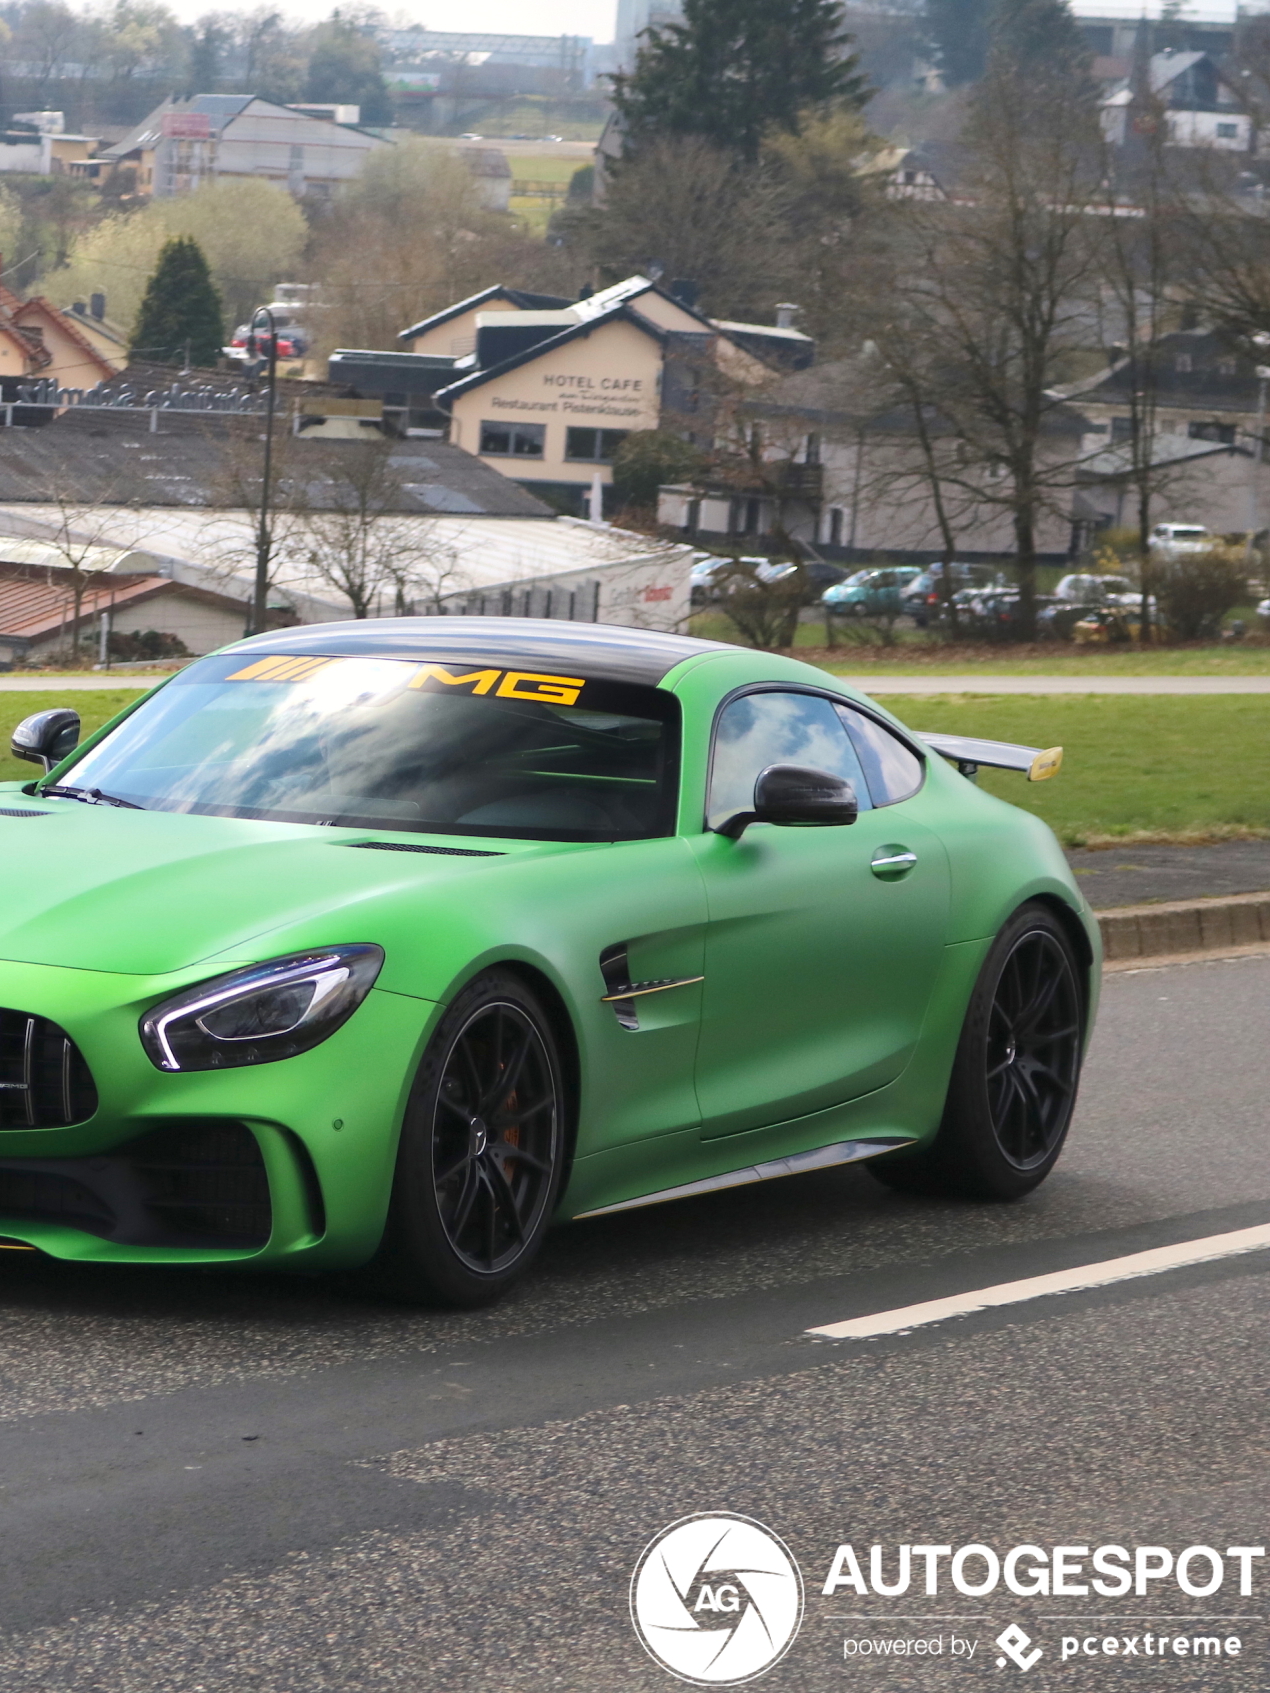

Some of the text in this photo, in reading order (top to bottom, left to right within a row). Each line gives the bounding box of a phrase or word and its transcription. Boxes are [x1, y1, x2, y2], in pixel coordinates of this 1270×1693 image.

[544, 375, 643, 391] HOTEL CAFE
[492, 397, 558, 411] Restaurant
